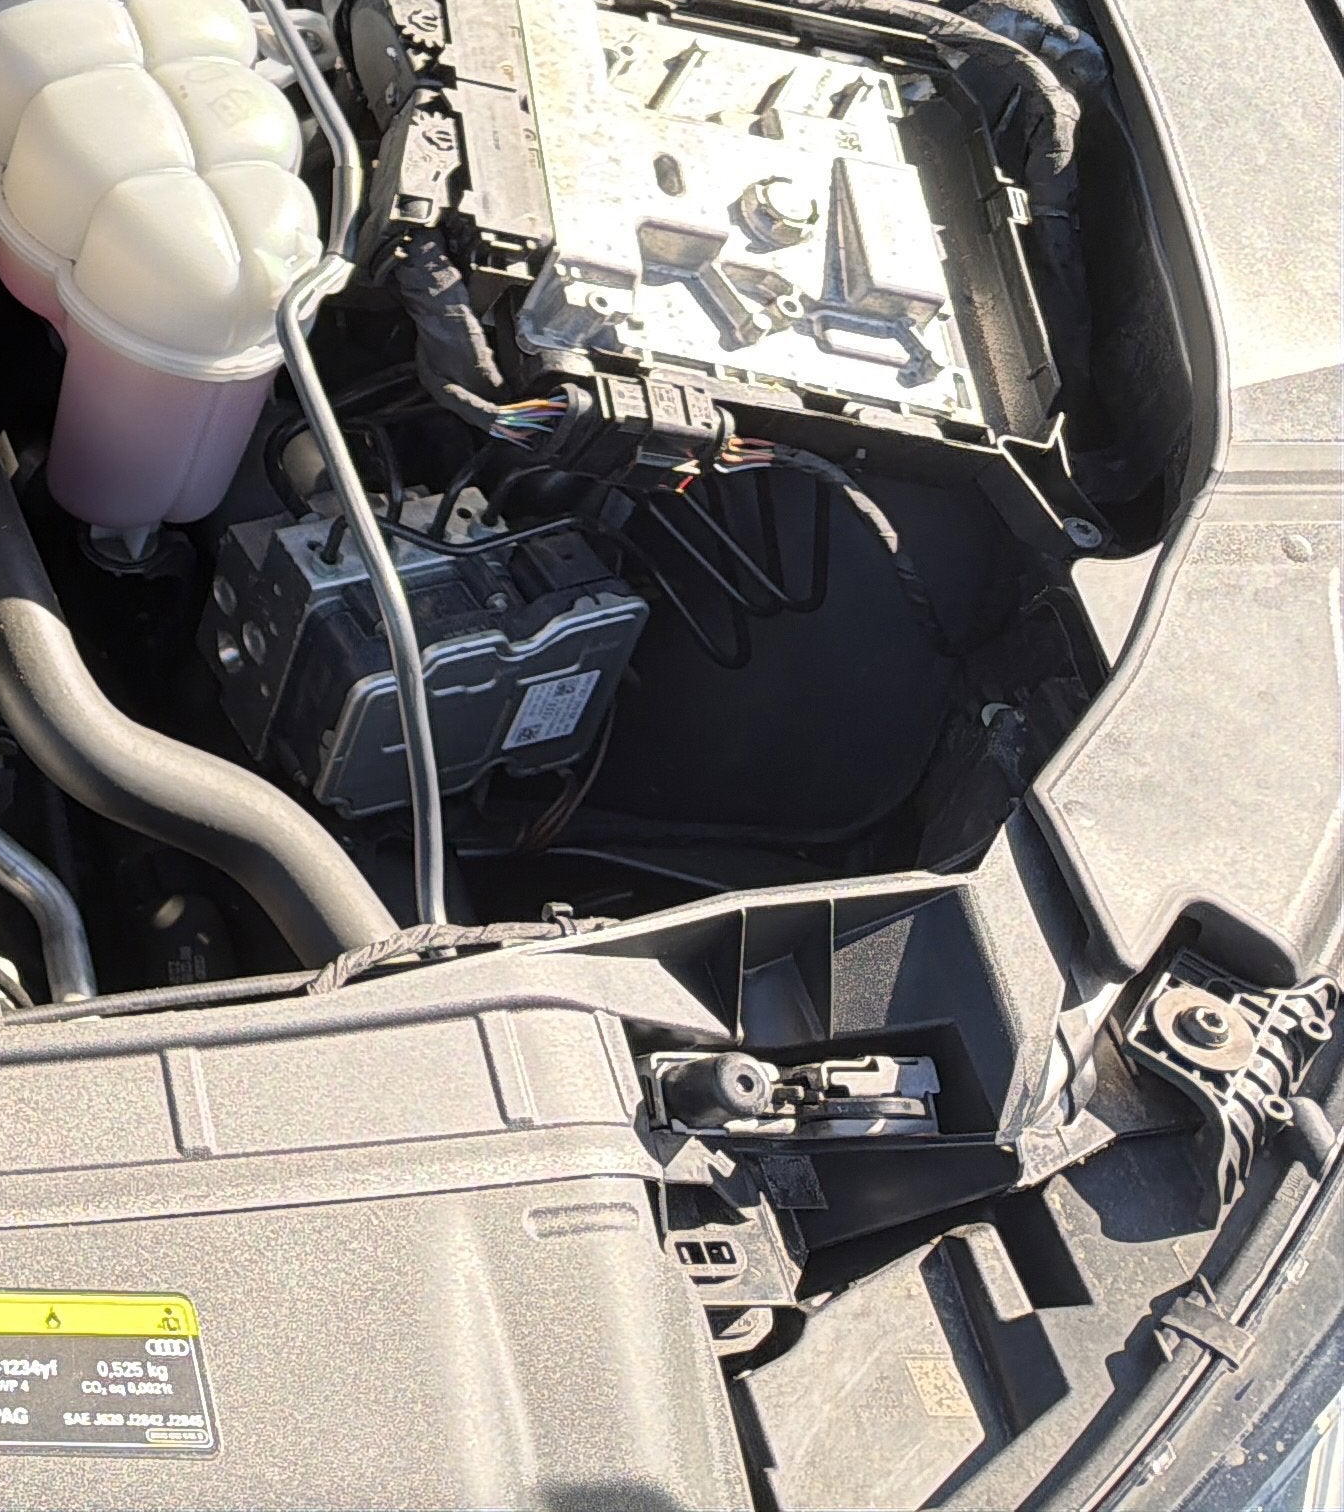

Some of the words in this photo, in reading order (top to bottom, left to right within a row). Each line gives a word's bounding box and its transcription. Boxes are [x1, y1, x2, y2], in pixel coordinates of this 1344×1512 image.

[96, 1360, 144, 1378] 0,525
[146, 1361, 169, 1381] kg
[62, 1412, 91, 1426] SAE
